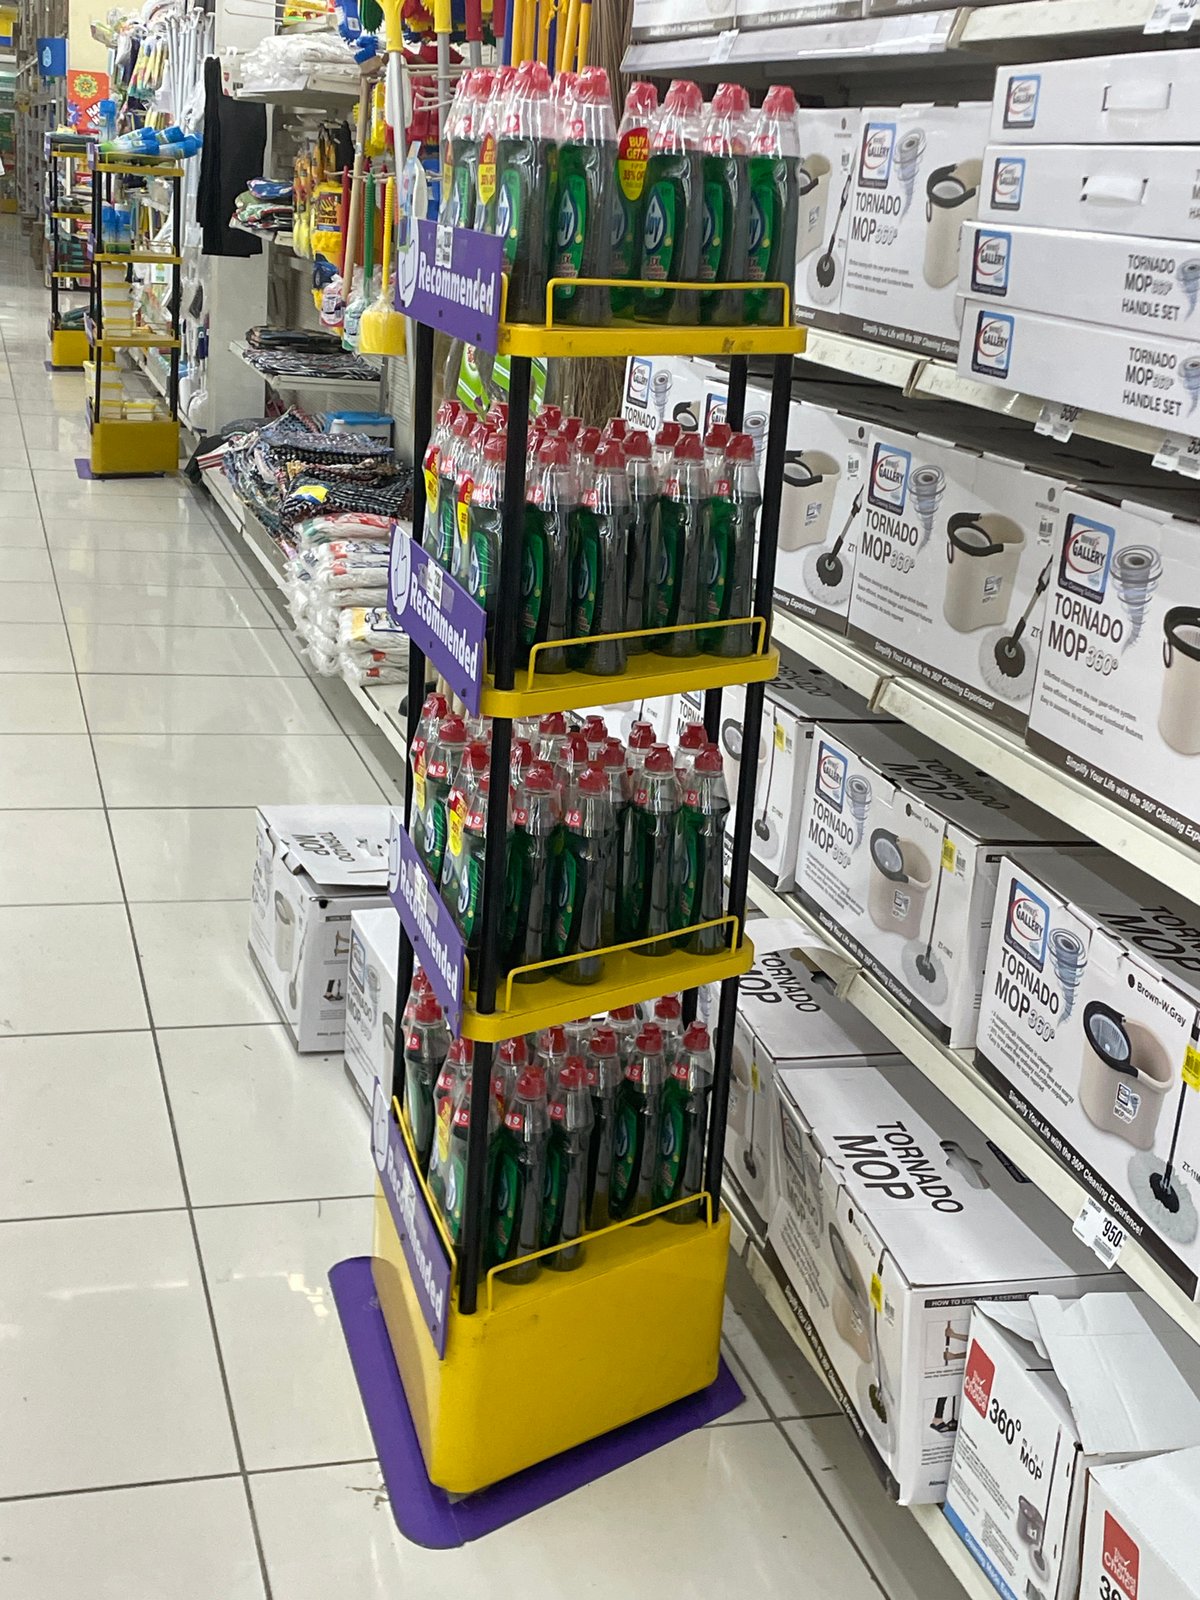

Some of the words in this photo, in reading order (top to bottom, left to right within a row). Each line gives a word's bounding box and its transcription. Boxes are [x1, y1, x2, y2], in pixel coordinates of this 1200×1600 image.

[856, 192, 901, 217] TORNADO
[851, 216, 876, 242] MOP
[981, 249, 1006, 266] GALLERY
[1128, 254, 1176, 274] TORNADO
[418, 251, 495, 317] Recommended
[1124, 273, 1153, 293] MOP
[1121, 298, 1160, 319] HANDLE
[1161, 306, 1180, 322] SET
[983, 331, 1009, 349] GALLERY
[1129, 347, 1177, 369] TORNADO
[1125, 365, 1153, 387] MOP
[624, 406, 656, 431] TORNADO
[1122, 390, 1161, 412] HANDLE
[1162, 399, 1184, 416] SET
[879, 464, 904, 485] GALLERY
[865, 508, 918, 546] TORNADO
[861, 532, 892, 565] MOP
[1073, 539, 1106, 568] GALLERY
[790, 597, 817, 615] Experience!
[1055, 592, 1124, 643] TORNADO
[409, 572, 479, 682] Recommended
[1048, 620, 1088, 662] MOP
[1085, 646, 1119, 676] 360°
[875, 641, 892, 659] Simplify
[892, 651, 903, 663] Your
[903, 652, 912, 669] Life
[912, 659, 923, 674] with
[922, 664, 931, 678] the
[942, 677, 963, 697] Cleaning
[963, 687, 994, 711] Experience!
[882, 763, 965, 801] MOP
[918, 759, 1010, 809] TORNADO
[1065, 755, 1089, 778] Simplify
[1089, 768, 1104, 784] Your
[1102, 777, 1116, 792] Life
[1115, 786, 1130, 800] with
[1129, 792, 1141, 807] the
[1140, 798, 1156, 814] 360°
[1155, 808, 1185, 835] Cleaning
[808, 818, 834, 855] MOP
[813, 798, 854, 846] TORNADO
[292, 833, 330, 857] MOP
[1016, 904, 1044, 938] GALLERY
[759, 951, 821, 1012] TORNADO
[1001, 946, 1059, 1014] TORNADO
[994, 971, 1030, 1018] MOP
[1027, 1008, 1055, 1042] 360°
[1137, 982, 1187, 1027] Brown-W.Gray
[833, 1135, 915, 1199] MOP
[877, 1121, 964, 1213] TORNADO
[1009, 1090, 1029, 1117] Simplify
[1028, 1110, 1041, 1127] Your
[1040, 1121, 1051, 1139] Life
[1050, 1133, 1063, 1152] with
[1061, 1143, 1072, 1161] the
[1071, 1155, 1084, 1173] 360°
[1083, 1169, 1109, 1201] Cleaning
[1108, 1194, 1144, 1237] Experience!
[931, 1299, 949, 1307] HOW
[951, 1298, 961, 1306] TO
[989, 1398, 1021, 1446] 360°
[1019, 1446, 1043, 1480] MOP
[1104, 1551, 1136, 1597] Choice
